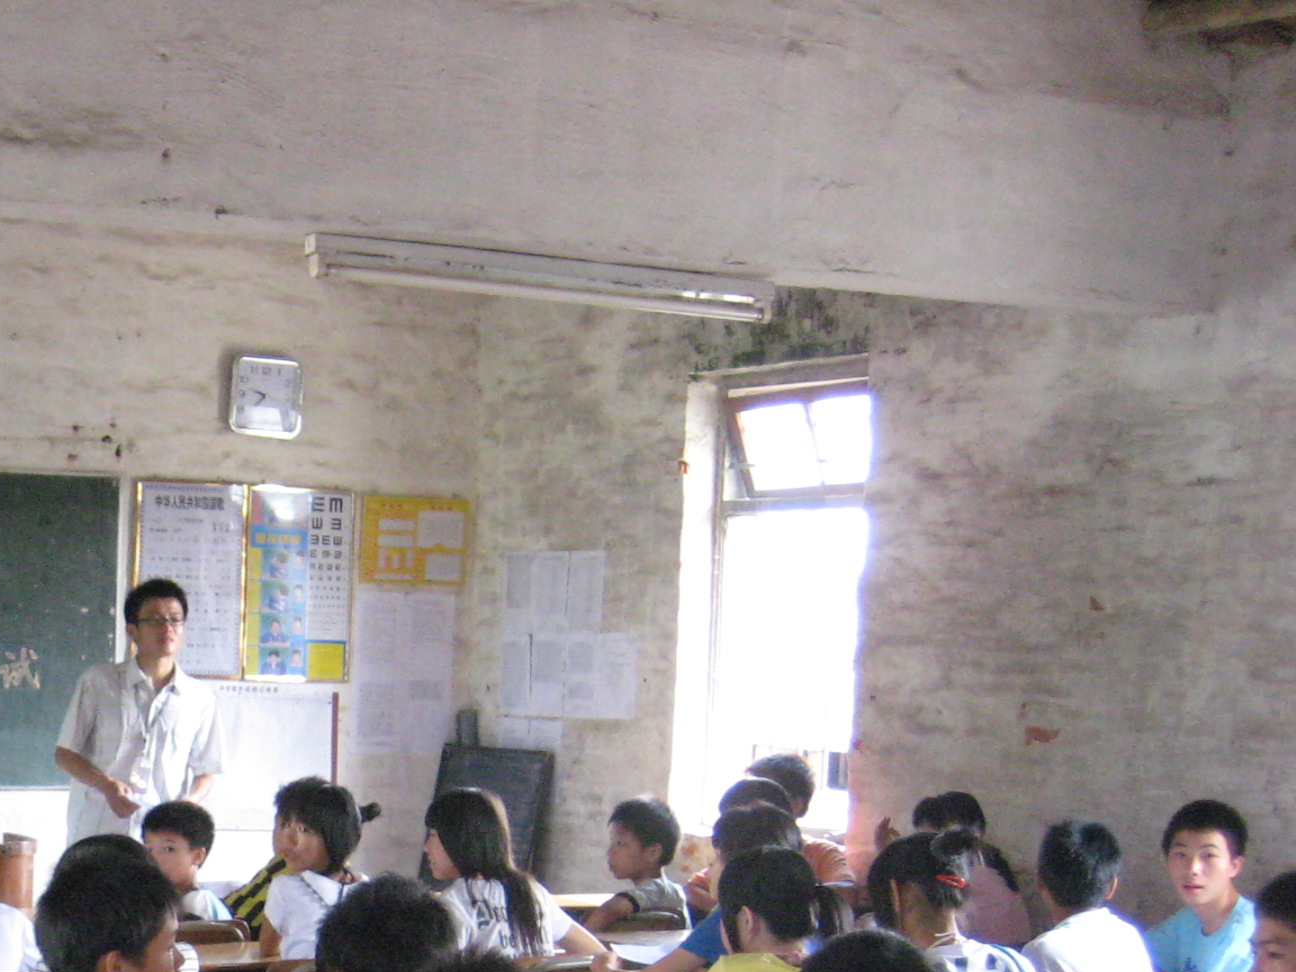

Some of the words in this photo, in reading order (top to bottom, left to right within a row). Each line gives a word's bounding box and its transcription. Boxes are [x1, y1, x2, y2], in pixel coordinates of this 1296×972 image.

[154, 494, 225, 511] 中华人民共和国国歌
